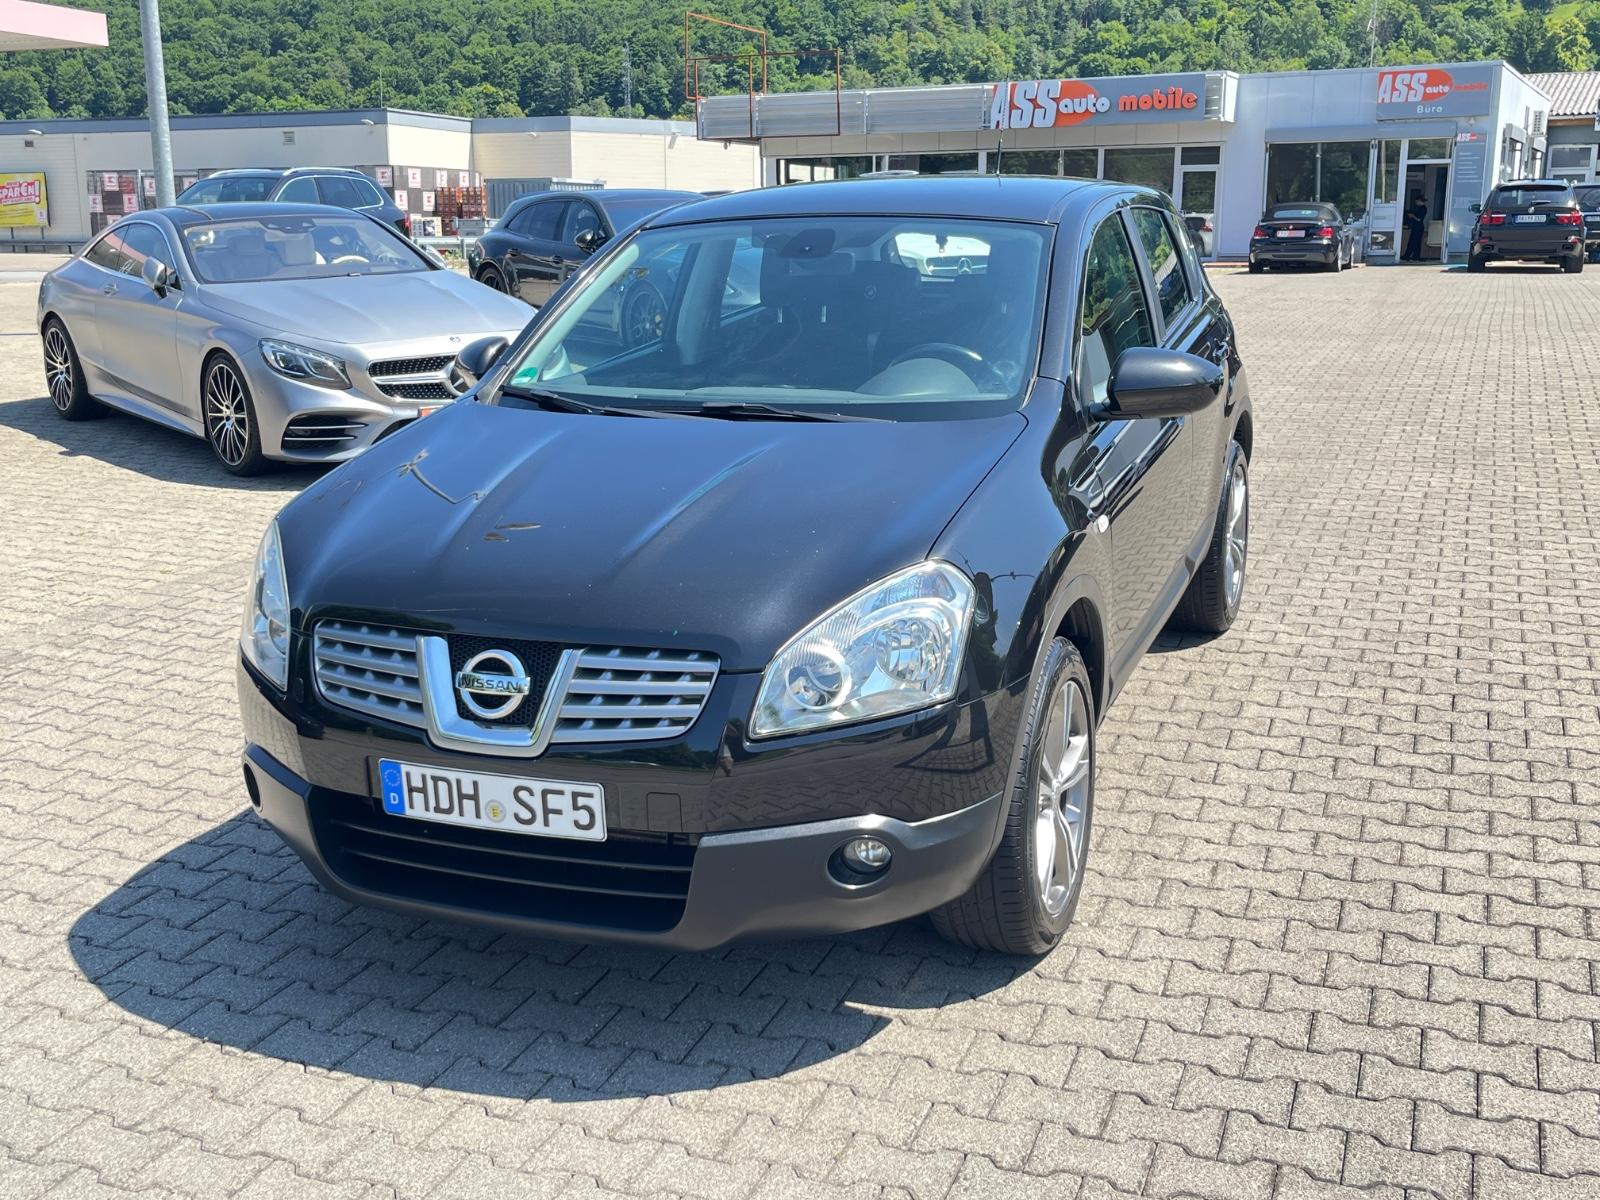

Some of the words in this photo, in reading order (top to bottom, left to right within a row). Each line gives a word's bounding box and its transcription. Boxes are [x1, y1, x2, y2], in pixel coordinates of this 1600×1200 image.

[1378, 72, 1427, 103] ASS
[1425, 84, 1450, 94] auto
[990, 81, 1061, 129] ASS
[1058, 94, 1111, 114] auto
[1118, 86, 1198, 112] mobile
[1416, 104, 1443, 114] Büro
[461, 676, 519, 692] NISSAN
[390, 792, 399, 804] D
[404, 772, 482, 820] HDH
[512, 785, 597, 831] SF5
